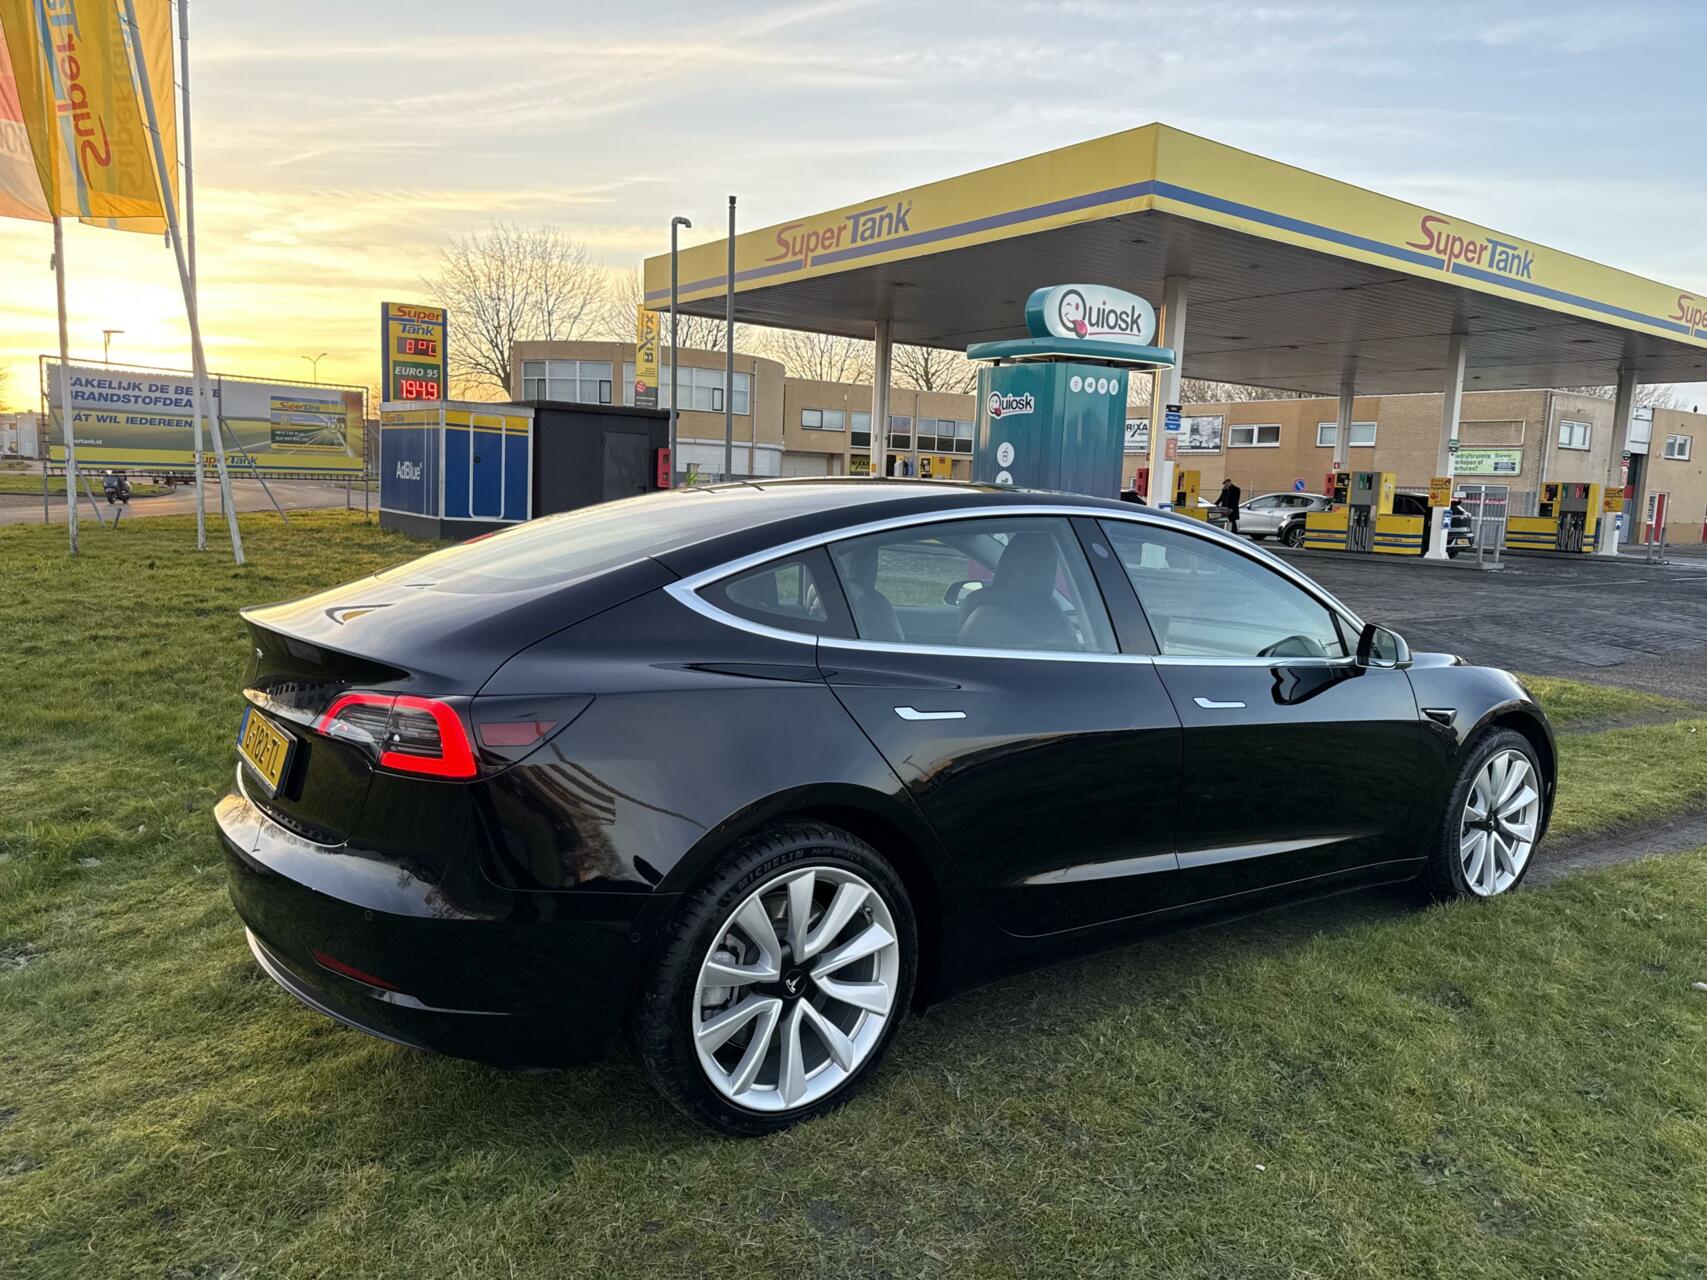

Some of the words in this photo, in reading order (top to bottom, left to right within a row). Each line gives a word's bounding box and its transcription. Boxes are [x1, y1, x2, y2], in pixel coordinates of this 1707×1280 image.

[764, 201, 912, 268] SuperTank
[1406, 215, 1534, 279] SuperTank
[390, 305, 441, 323] Super
[1058, 289, 1141, 339] Quiosk
[398, 322, 434, 336] Tank
[394, 366, 424, 377] EURO
[426, 369, 438, 378] 95
[70, 390, 194, 408] RANDSTOFDEA
[148, 383, 170, 394] DE
[174, 385, 221, 398] BEE
[988, 393, 1033, 417] Quiosk
[72, 411, 92, 422] ÁT
[95, 414, 121, 424] WIL
[1126, 421, 1148, 438] RIXA
